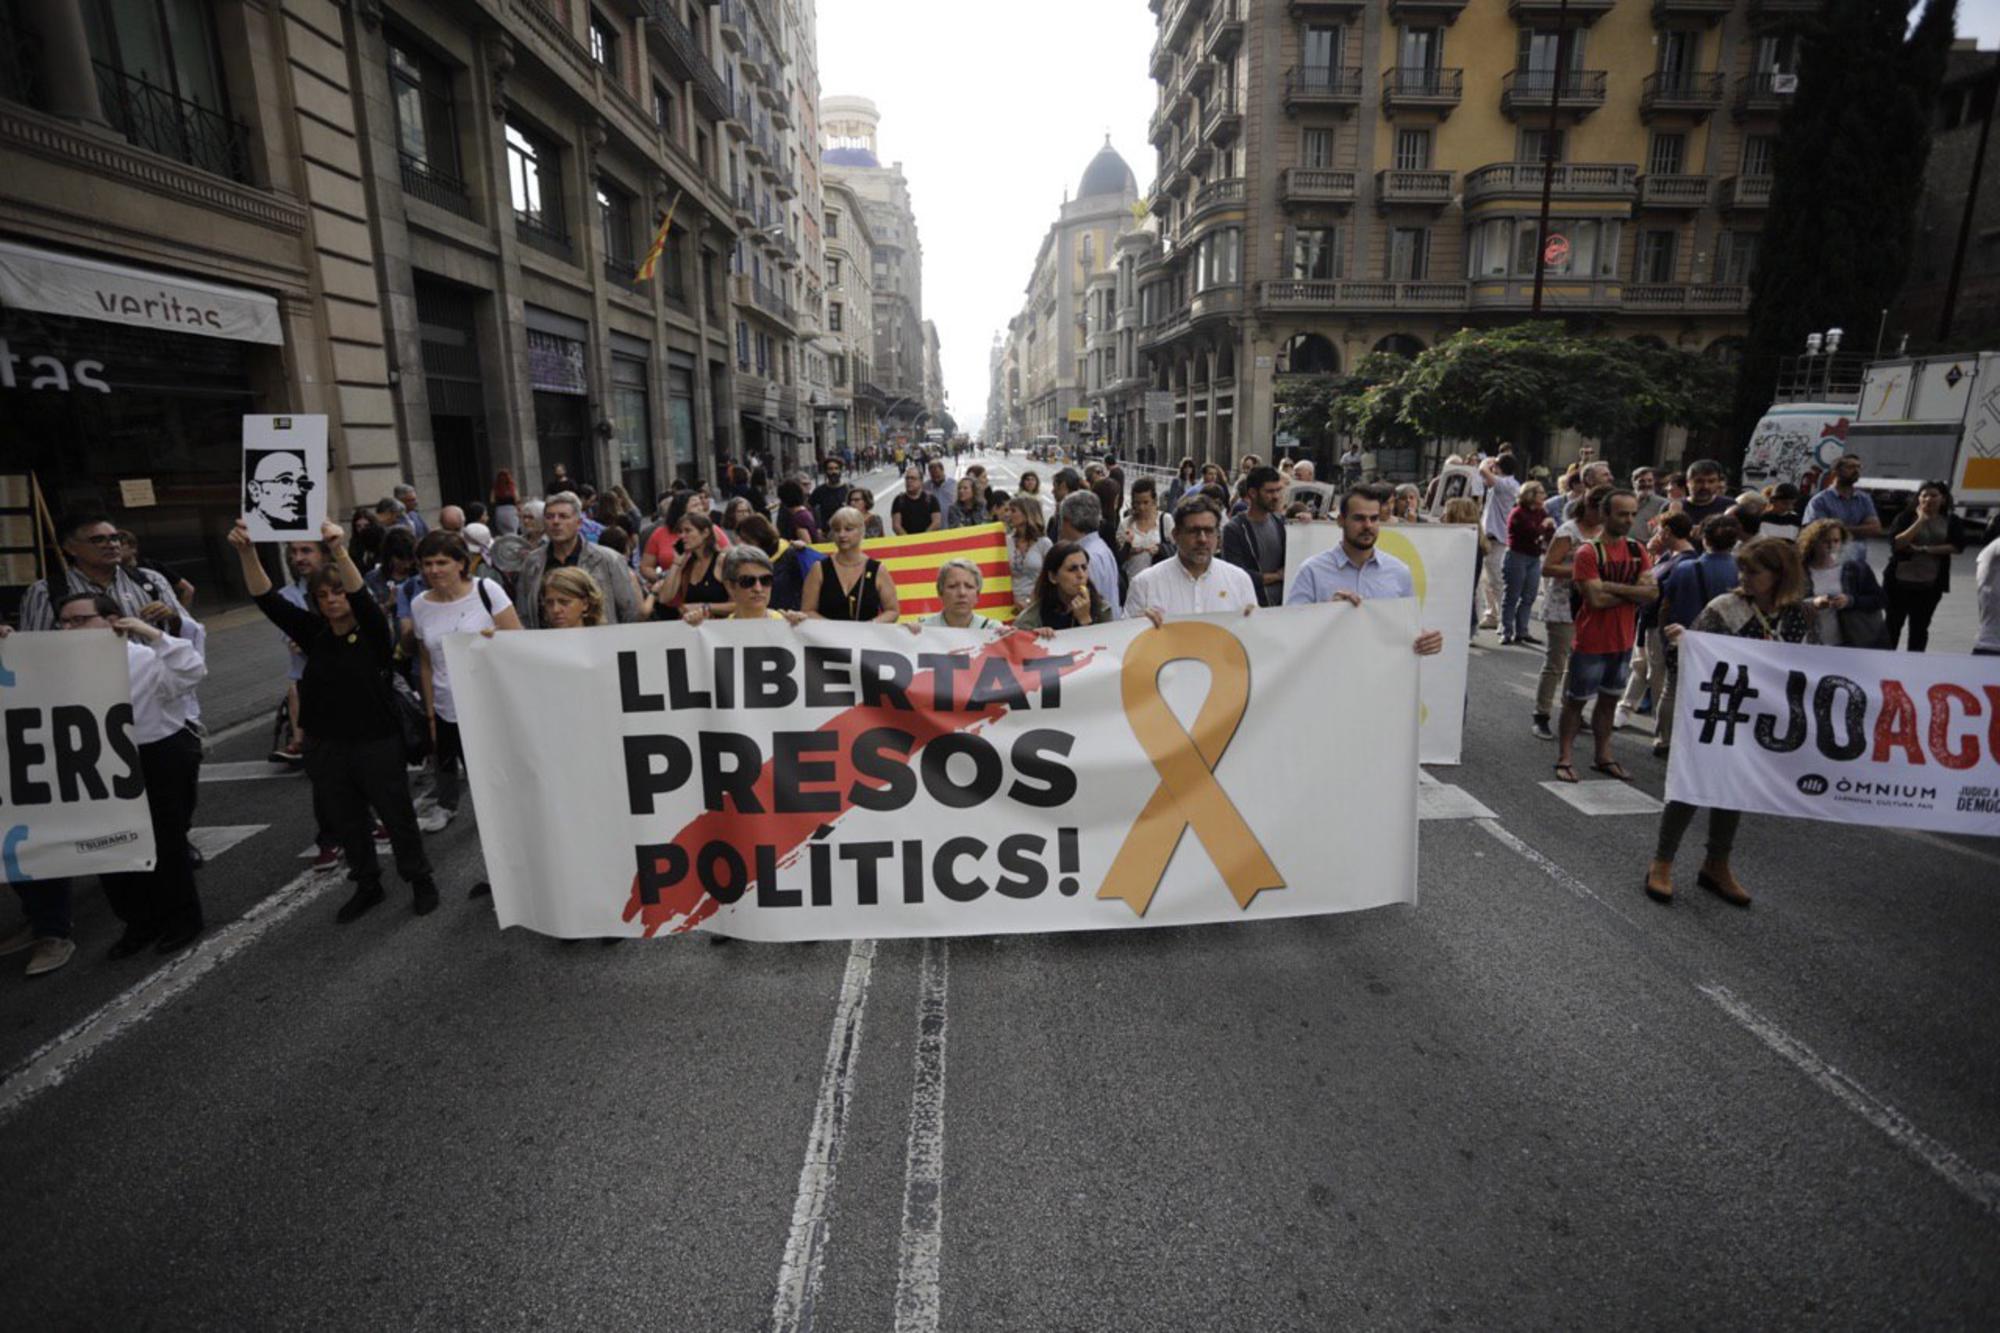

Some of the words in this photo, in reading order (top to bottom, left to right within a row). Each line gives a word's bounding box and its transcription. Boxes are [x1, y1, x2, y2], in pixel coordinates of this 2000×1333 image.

[96, 290, 222, 329] veritas
[617, 646, 1074, 713] LLIBERTAT
[0, 703, 146, 805] ERS
[623, 728, 1077, 814] PRESOS
[1836, 776, 1937, 800] ÒMNIUM
[635, 824, 1080, 908] POLÍTICS!
